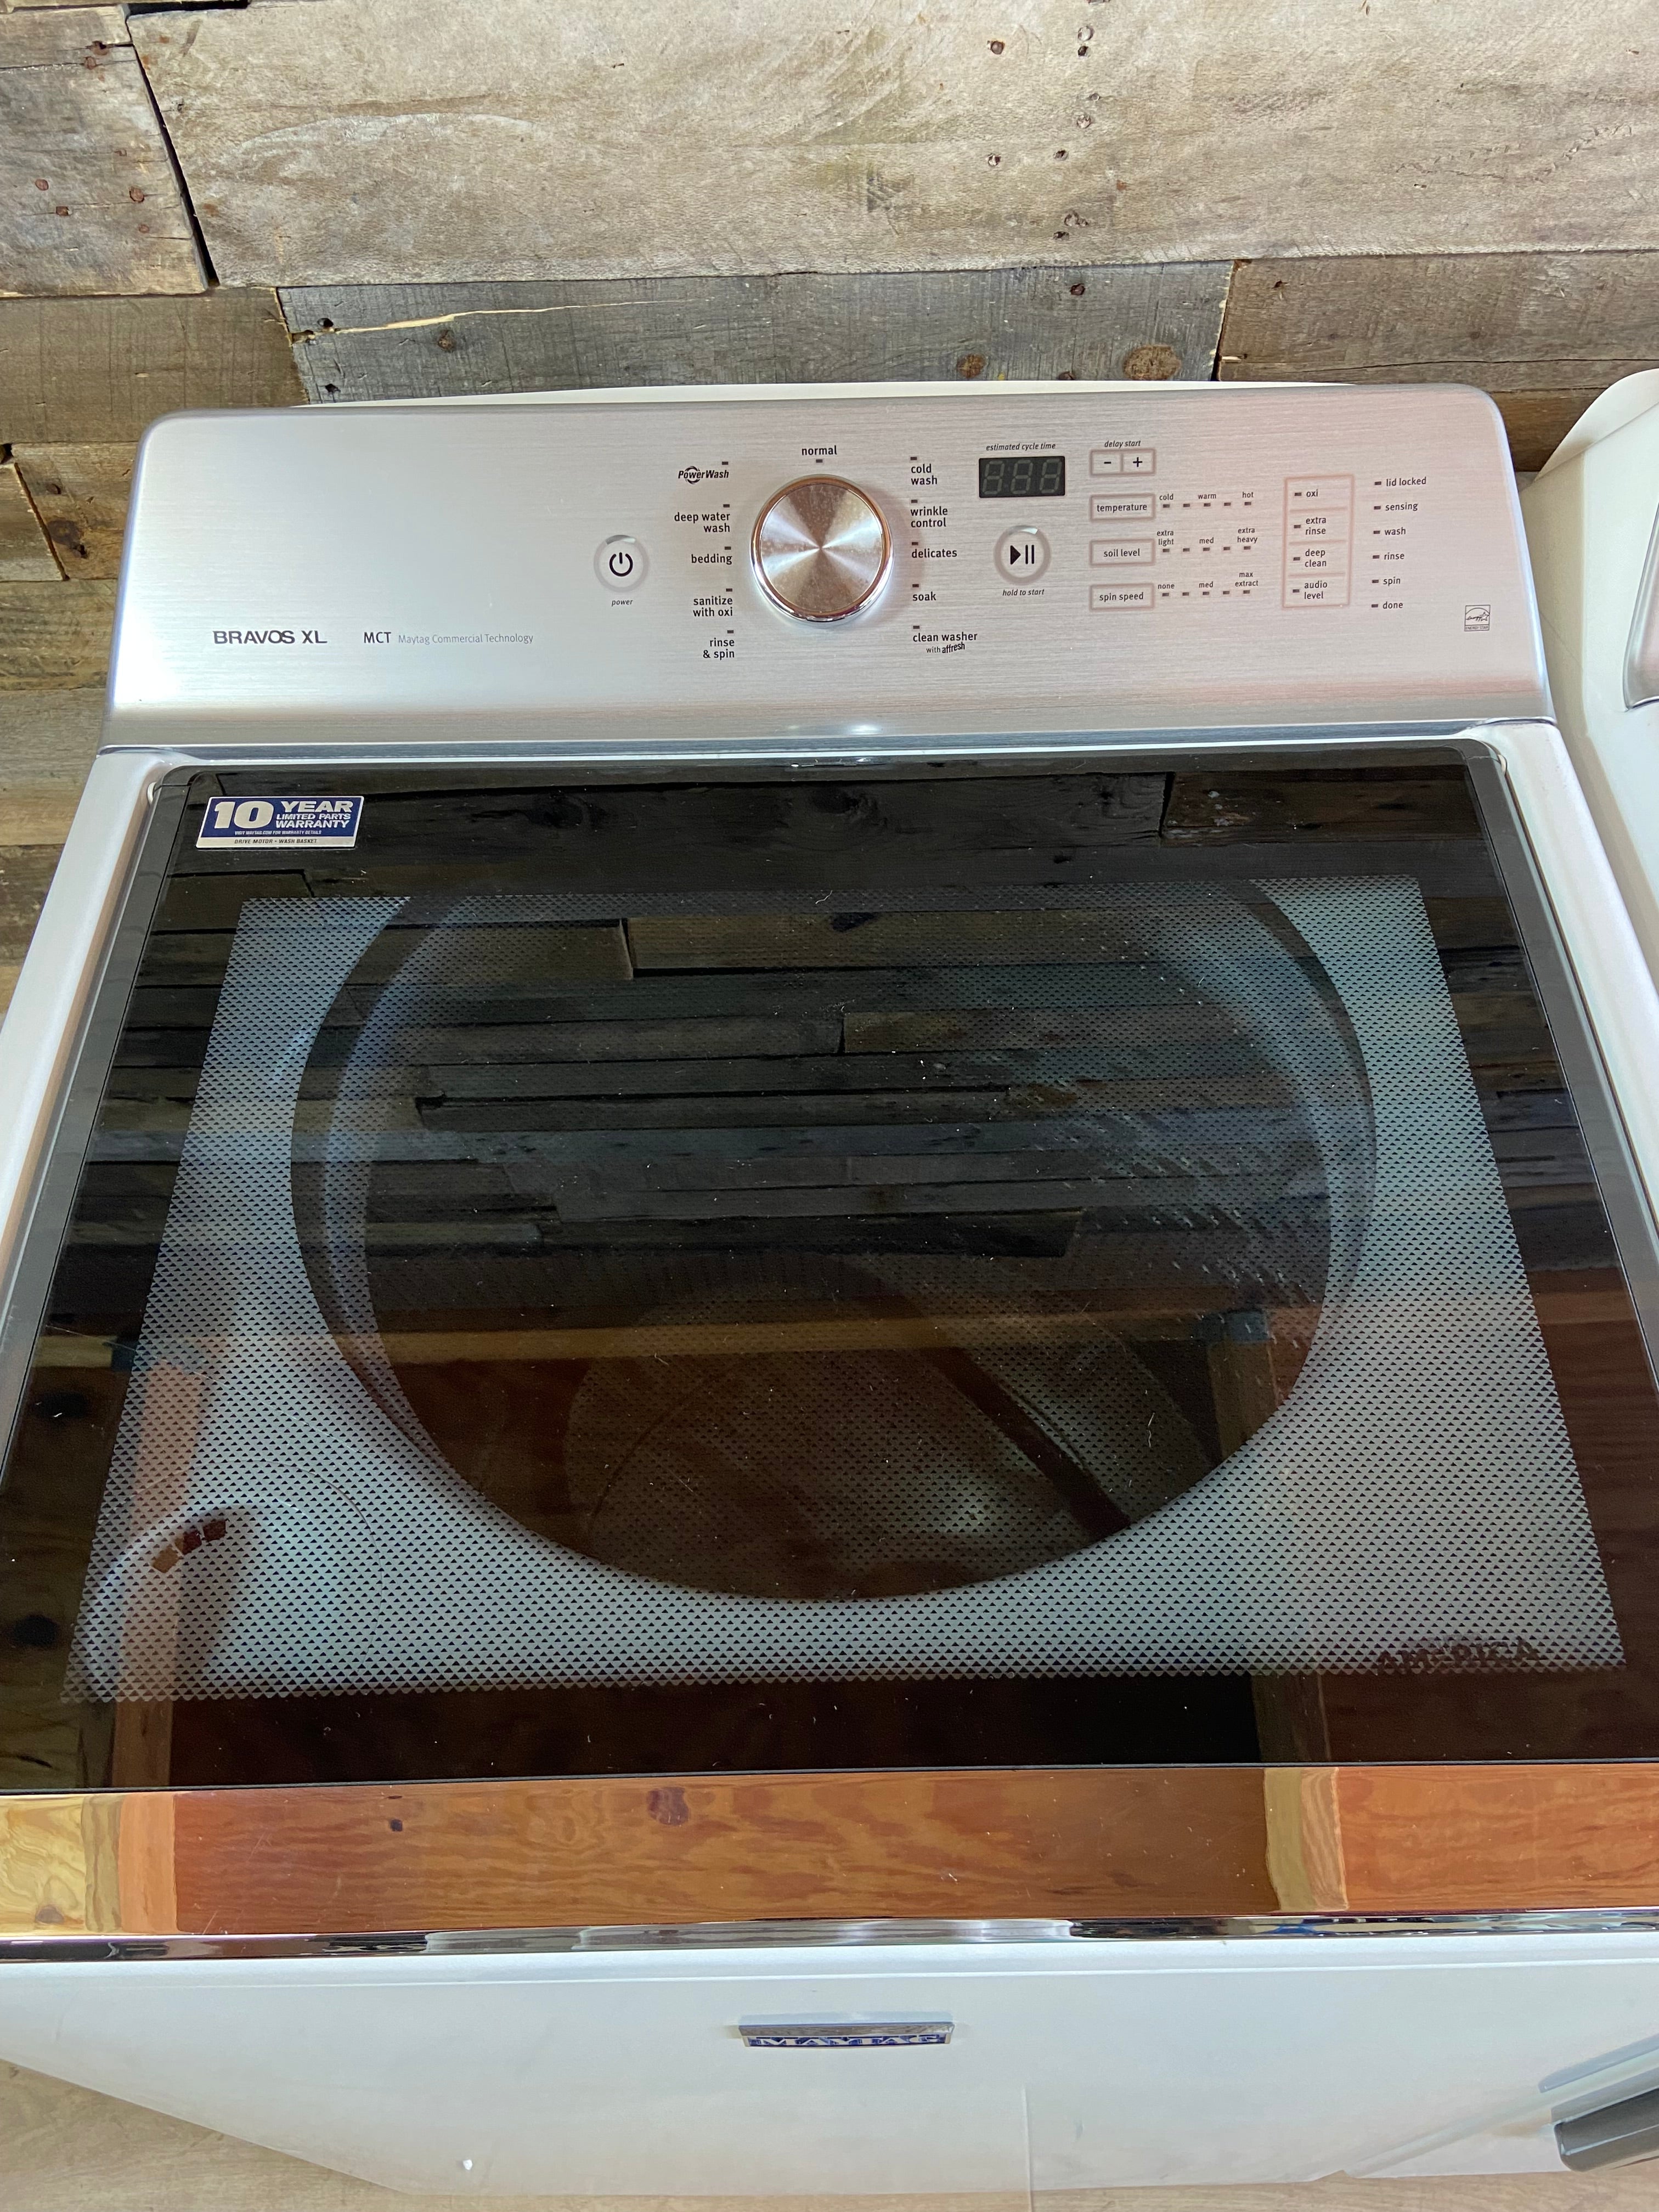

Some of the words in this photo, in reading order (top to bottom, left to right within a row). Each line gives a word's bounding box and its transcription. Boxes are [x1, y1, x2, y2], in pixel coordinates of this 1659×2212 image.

[986, 443, 1020, 451] estimated
[1022, 442, 1039, 452] cycle
[1040, 442, 1056, 450] time
[1104, 440, 1124, 449] delay
[802, 445, 837, 456] normal
[911, 463, 932, 473] cold
[911, 475, 938, 486] wash
[1386, 478, 1397, 487] lid
[1399, 476, 1426, 486] locked
[1306, 489, 1318, 498] oxi
[910, 506, 948, 516] wrinkle
[1097, 503, 1147, 514] temperature
[1385, 502, 1418, 512] sensing
[674, 511, 699, 524] deep
[701, 512, 731, 521] water
[911, 517, 946, 528] control
[703, 522, 730, 533] wash
[1305, 527, 1326, 535] rinse
[1384, 527, 1406, 535] wash
[1158, 538, 1174, 547] light
[911, 548, 957, 558] delicates
[1103, 549, 1119, 557] soil
[1121, 548, 1140, 557] level
[1305, 548, 1326, 558] deep
[1384, 552, 1405, 560] rinse
[691, 553, 733, 565] bedding
[1305, 559, 1327, 568] clean
[1304, 580, 1328, 589] audio
[1383, 576, 1401, 586] spin
[693, 595, 733, 606] sanitize
[912, 591, 936, 601] soak
[1099, 592, 1116, 602] spin
[1119, 591, 1144, 602] speed
[1304, 591, 1324, 600] level
[1383, 601, 1403, 610] done
[693, 607, 715, 617] with
[718, 606, 733, 617] oxi
[212, 630, 295, 644] BRAVOS
[301, 630, 328, 644] XL
[364, 631, 392, 644] MCT
[398, 635, 430, 646] Maytag
[432, 634, 483, 644] Commercial
[484, 633, 533, 644] Technology
[913, 632, 939, 642] clean
[941, 631, 978, 641] washer
[709, 637, 735, 647] rinse
[942, 642, 965, 653] affresh
[703, 650, 711, 659] &
[714, 648, 735, 661] spin
[281, 800, 353, 812] YEAR
[214, 801, 274, 828] 10
[276, 820, 349, 828] WARRANTY
